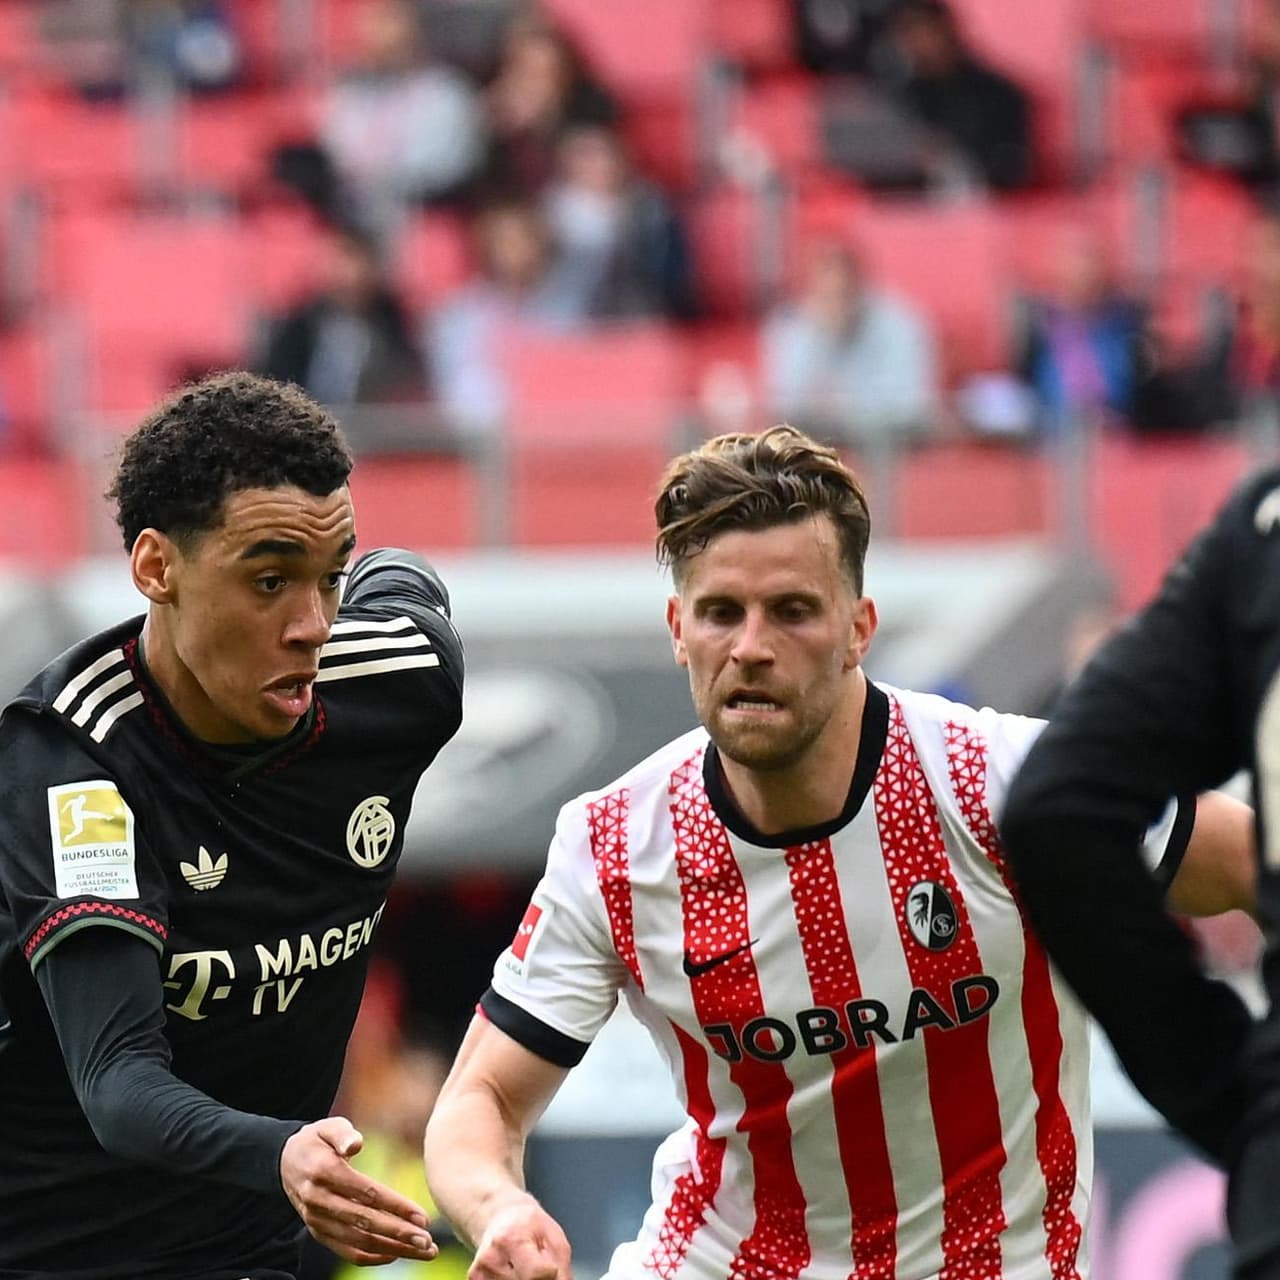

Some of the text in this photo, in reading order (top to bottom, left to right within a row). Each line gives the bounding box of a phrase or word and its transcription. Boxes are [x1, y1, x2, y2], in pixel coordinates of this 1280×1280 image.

[61, 848, 129, 862] BUNDESLIGA
[76, 871, 119, 880] DEUTSCHER
[252, 967, 305, 1017] TV
[702, 975, 1001, 1064] JOBRAD
